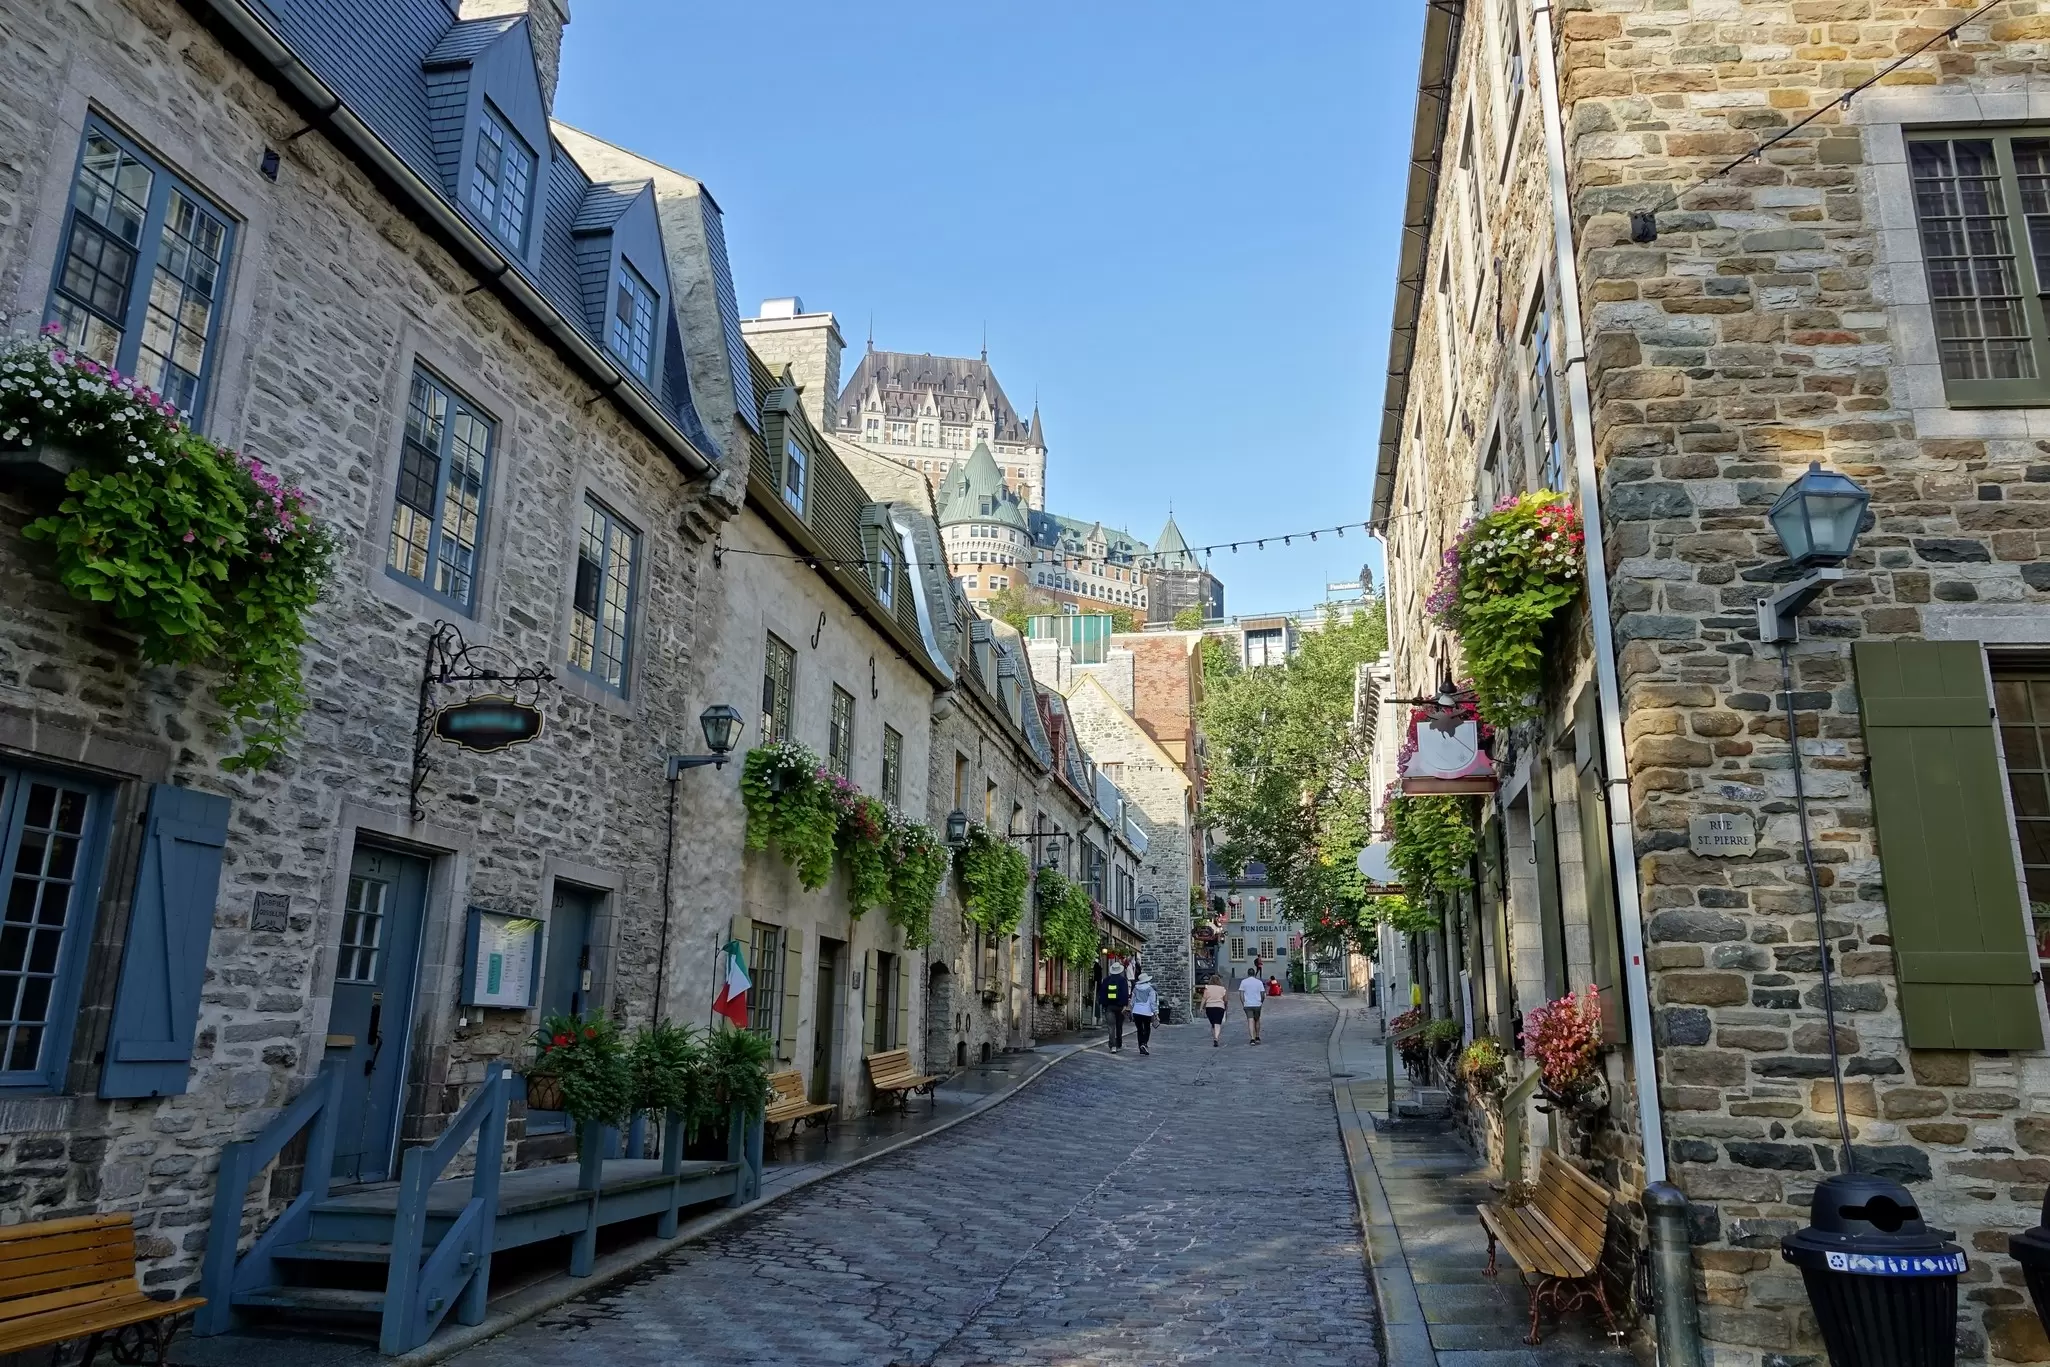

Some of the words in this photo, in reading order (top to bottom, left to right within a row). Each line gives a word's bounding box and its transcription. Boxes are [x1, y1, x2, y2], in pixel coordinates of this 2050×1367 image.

[1709, 820, 1733, 830] RUE
[1697, 835, 1712, 845] ST.
[1714, 835, 1750, 846] PIERRE
